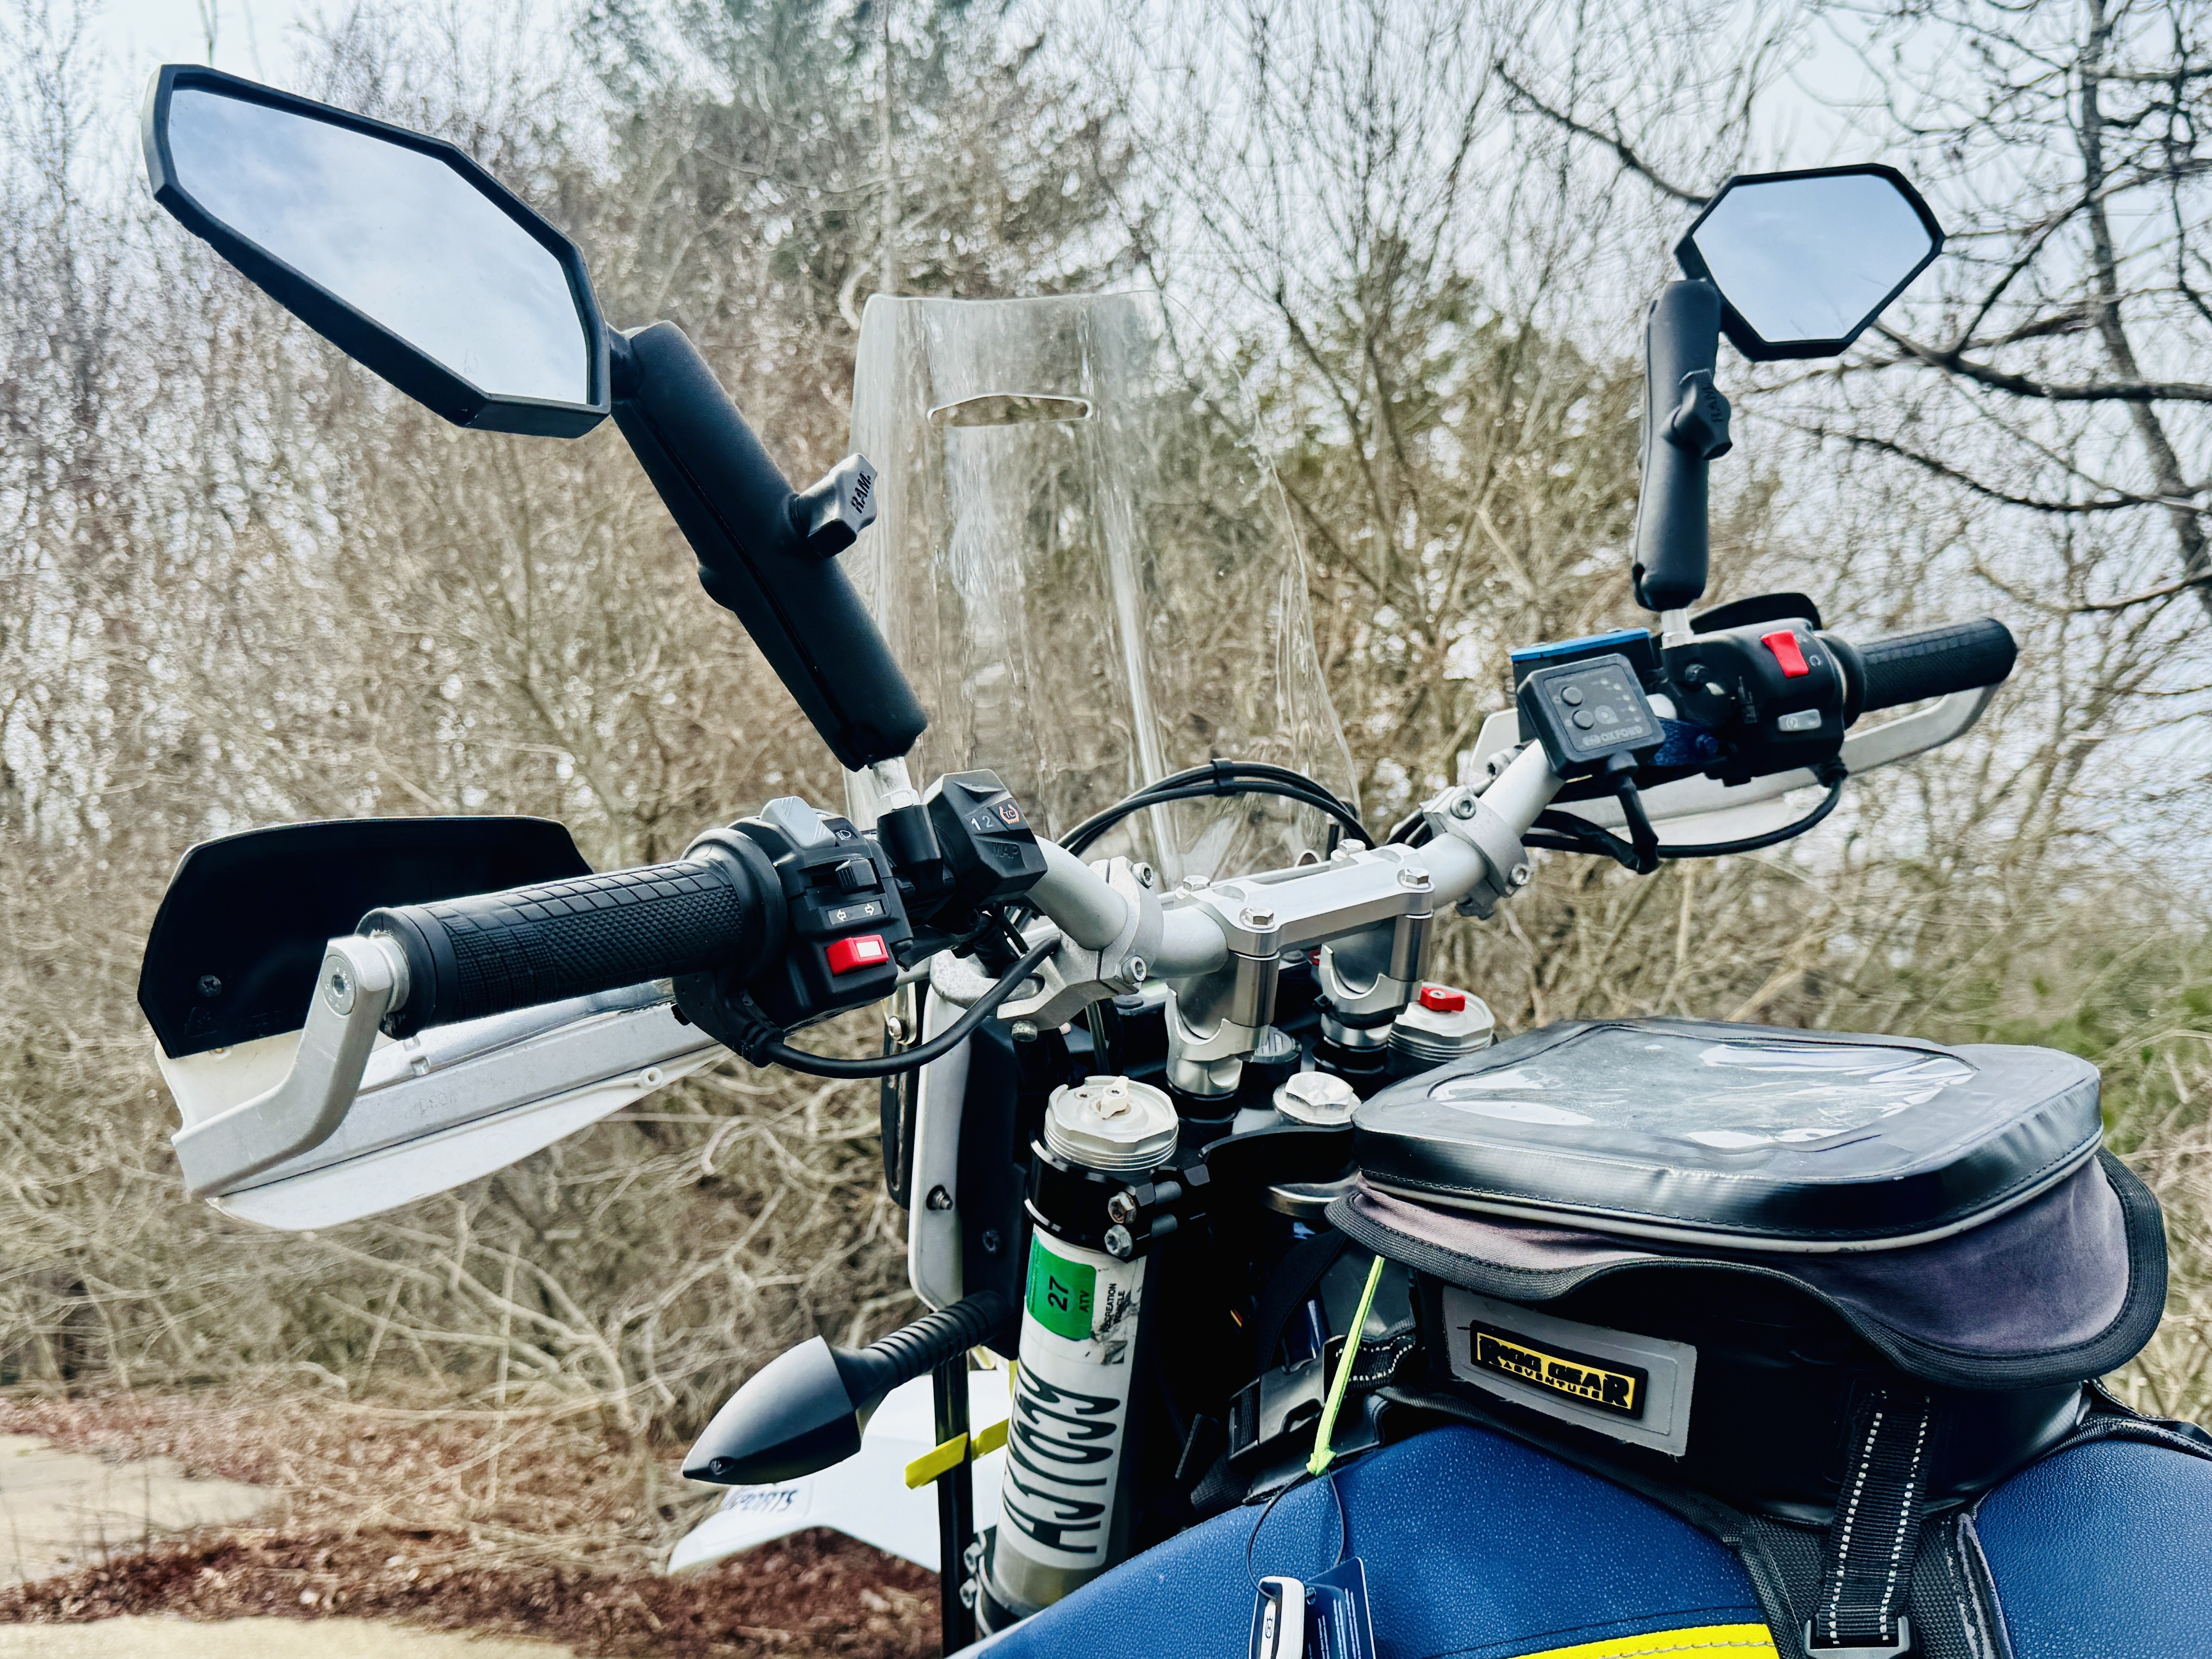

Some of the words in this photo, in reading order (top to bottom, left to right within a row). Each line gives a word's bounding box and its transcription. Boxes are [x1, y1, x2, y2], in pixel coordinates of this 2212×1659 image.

[1601, 726, 1642, 741] OXFORD
[1048, 1275, 1069, 1312] 27
[1079, 1290, 1090, 1313] ATV
[1104, 1283, 1117, 1332] RECREATION
[1479, 1336, 1542, 1372] RIGG
[1548, 1361, 1629, 1407] GEAR
[1503, 1362, 1600, 1399] ADVENTURE
